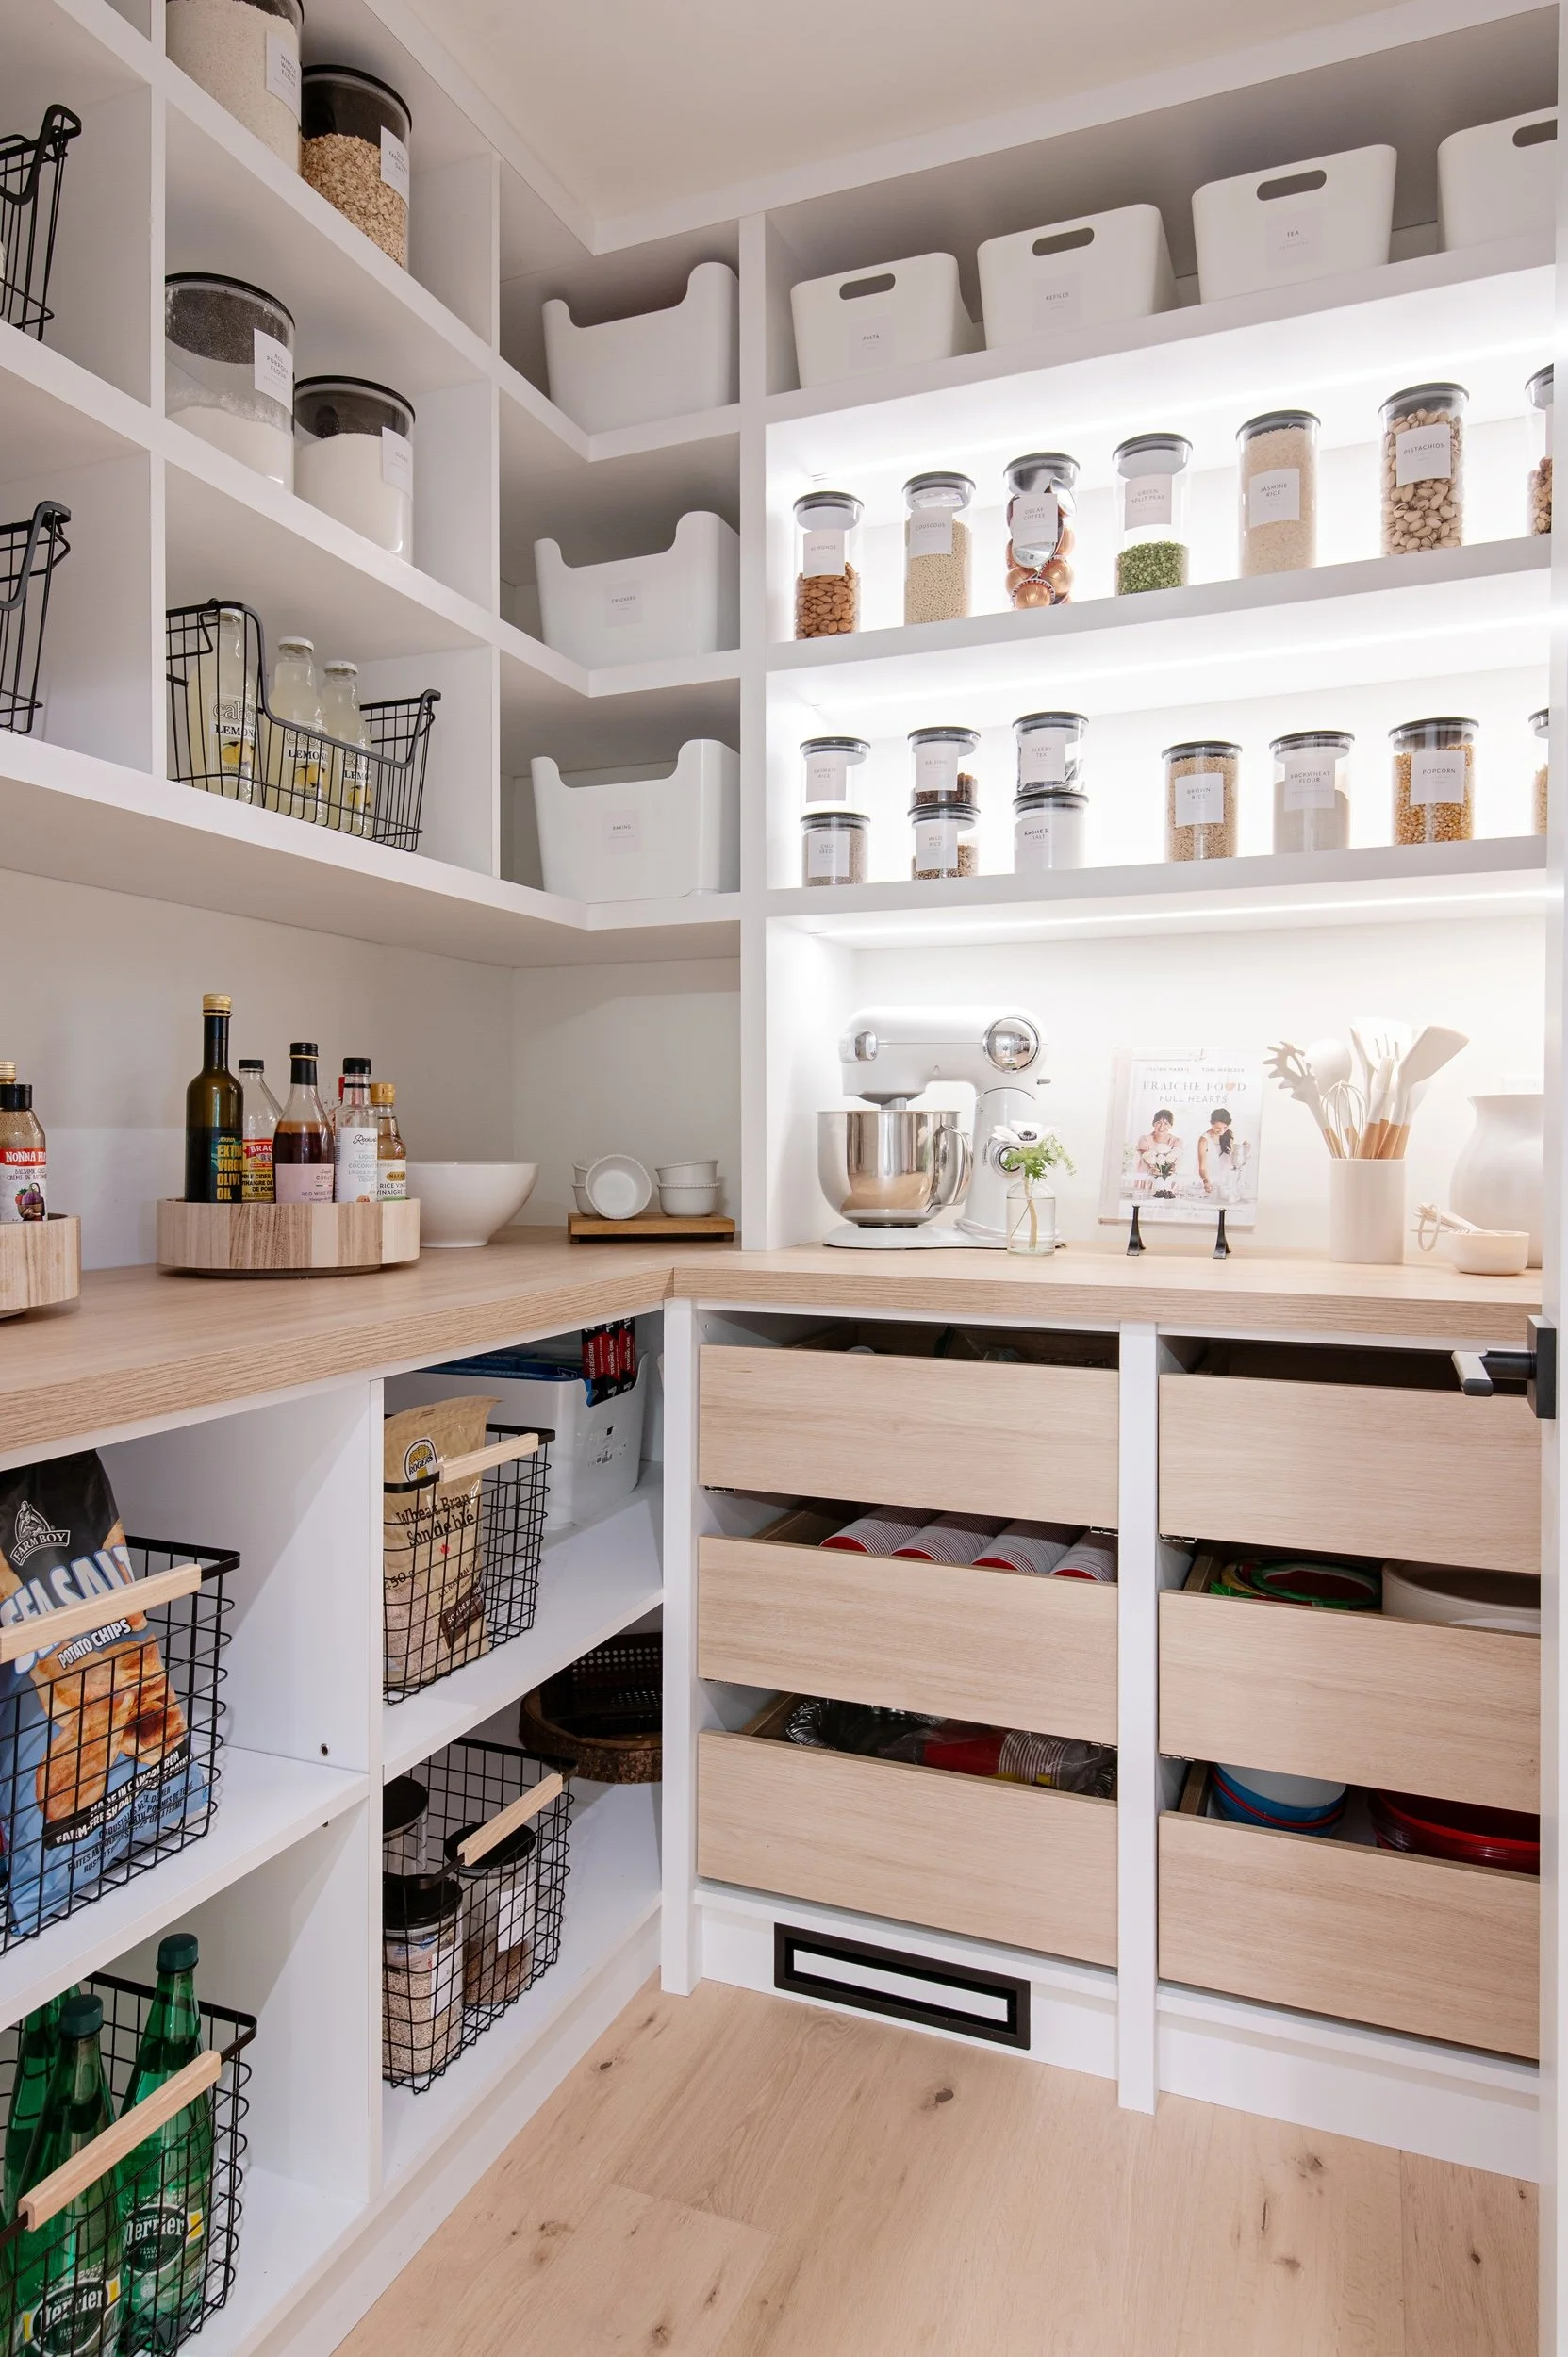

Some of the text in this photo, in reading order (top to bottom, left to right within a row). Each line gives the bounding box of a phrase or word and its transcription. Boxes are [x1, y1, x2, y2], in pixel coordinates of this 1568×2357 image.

[1046, 292, 1069, 301] REFILLS
[1403, 442, 1444, 455] PISTACHIOS
[1260, 483, 1288, 493] JASMINE
[1266, 489, 1281, 498] RICE
[1023, 513, 1045, 521] COFFEE
[915, 522, 946, 532] COUSCOUS
[611, 595, 636, 603] CRACKERS
[1290, 771, 1330, 780] BUCKWHEAT
[1159, 1095, 1228, 1104] FULL HEARTS
[6, 1150, 36, 1162] NONNA
[217, 1187, 232, 1200] OIL
[408, 1456, 434, 1475] ROGERS
[396, 1492, 471, 1526] Wheat Bran
[407, 1528, 433, 1548] Son
[12, 1532, 67, 1562] FARM BOY
[57, 1618, 132, 1670] POTATO CHIPS
[136, 2213, 158, 2223] SOURCE
[125, 2212, 186, 2246] Perrier
